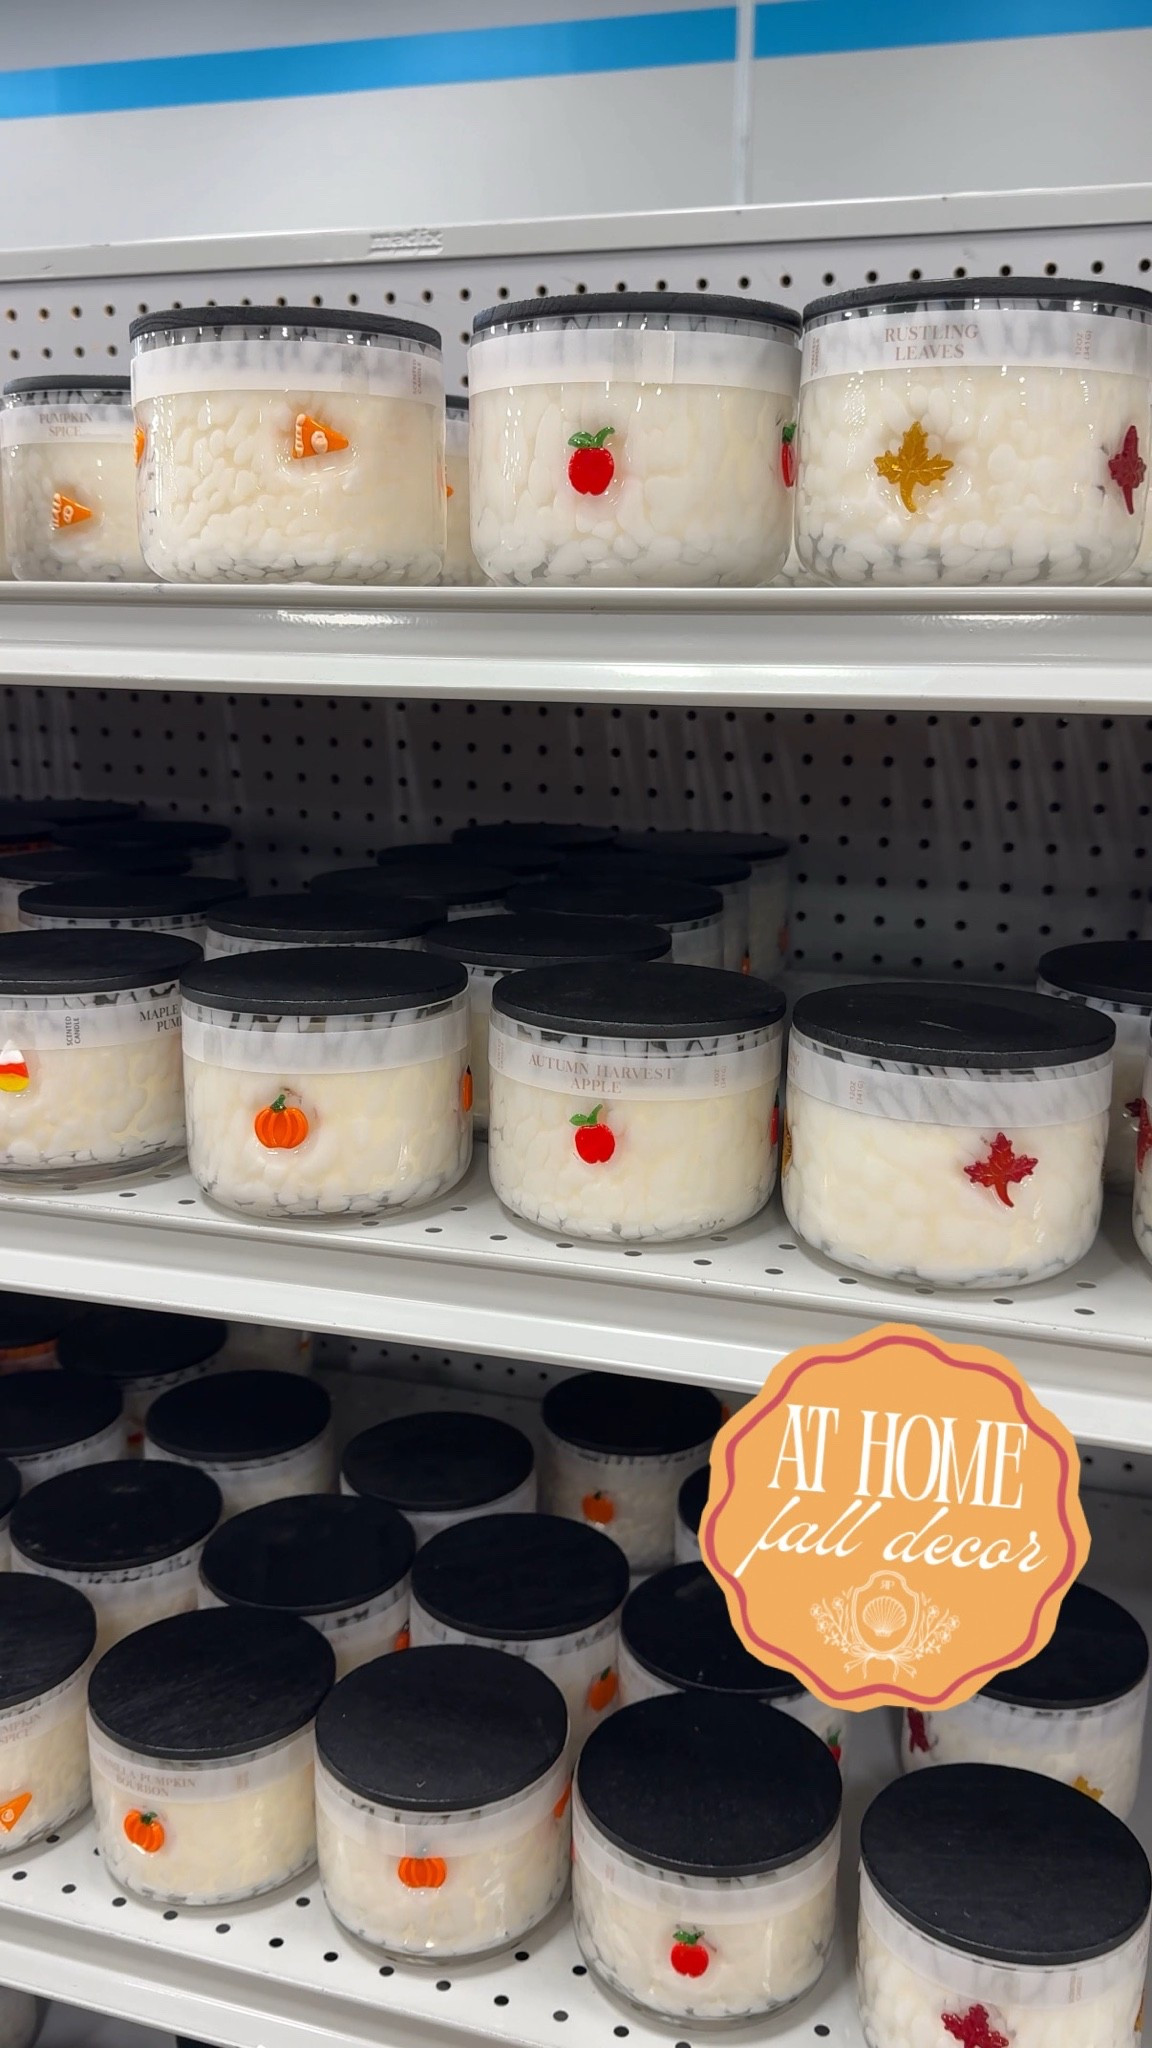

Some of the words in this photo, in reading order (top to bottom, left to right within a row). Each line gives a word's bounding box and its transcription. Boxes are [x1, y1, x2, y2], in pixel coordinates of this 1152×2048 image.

[885, 324, 979, 342] RUSTLING
[895, 343, 964, 361] LEAVES
[39, 412, 93, 424] PUMPKIN
[48, 426, 81, 437] SPICE
[139, 1004, 179, 1021] MAPLE
[65, 1016, 73, 1046] SCENTED
[528, 1054, 590, 1075] AUTUMN
[596, 1064, 675, 1080] HARVEST
[571, 1077, 622, 1093] APPLE
[116, 1774, 169, 1797] BOURBON
[140, 1773, 196, 1788] PUMPKIN
